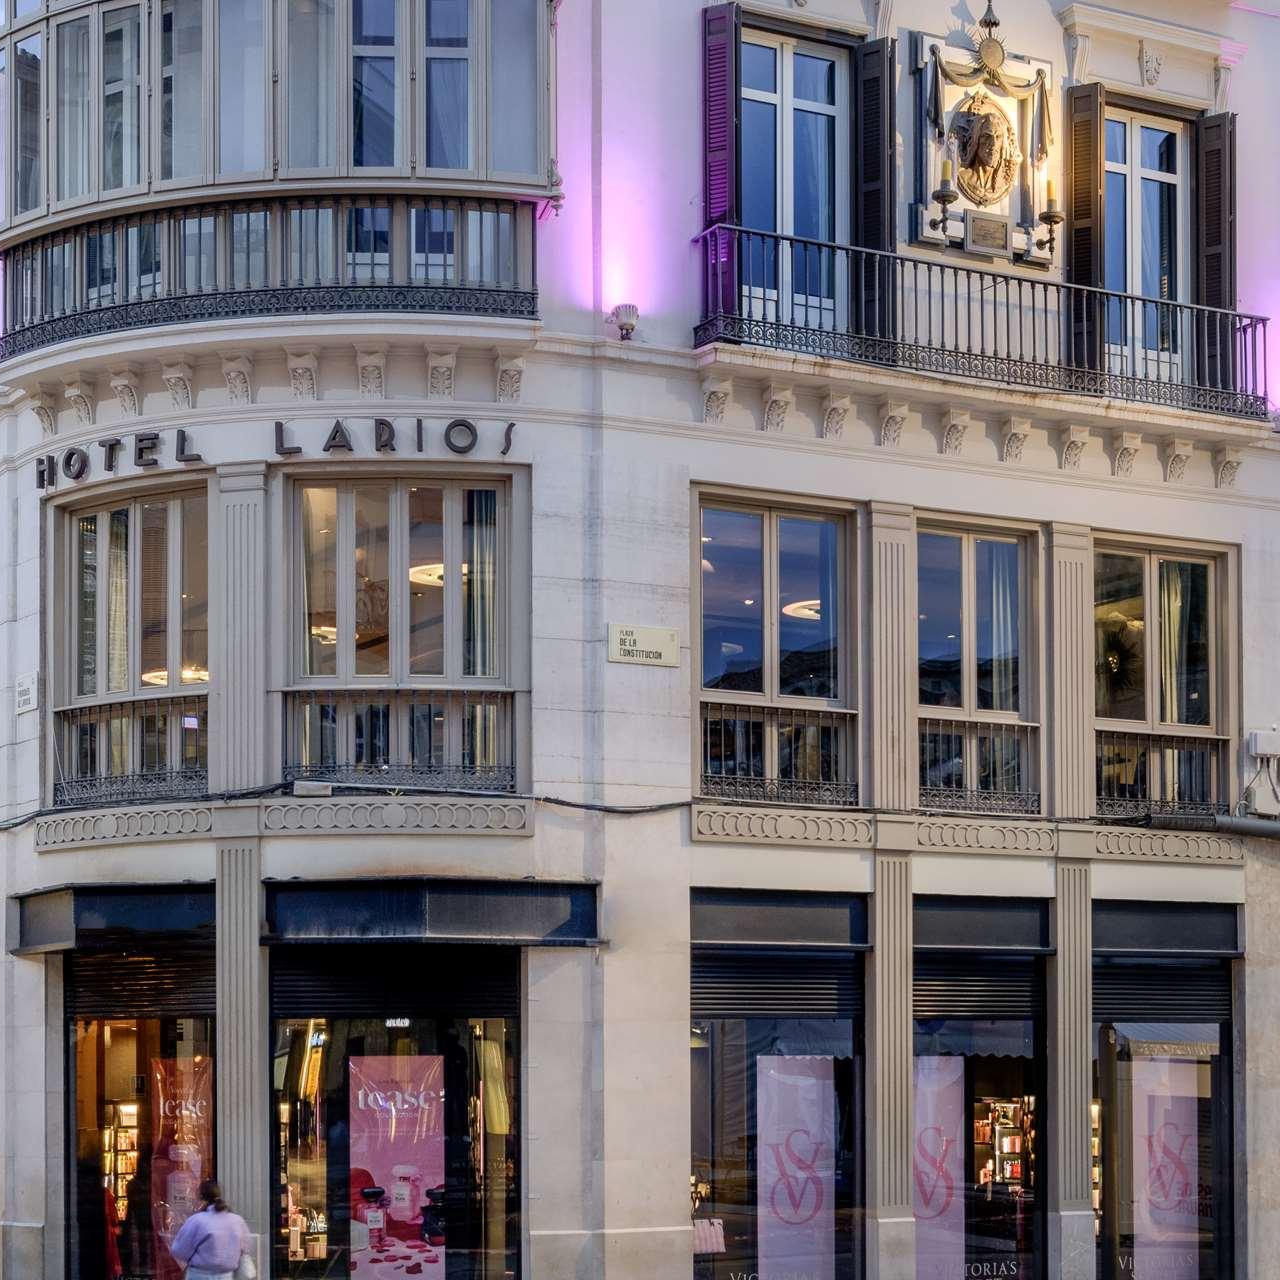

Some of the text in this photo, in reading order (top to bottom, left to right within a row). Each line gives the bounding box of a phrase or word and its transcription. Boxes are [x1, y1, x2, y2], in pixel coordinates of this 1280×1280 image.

[35, 418, 516, 489] HOTEL LARIOS
[619, 638, 637, 647] DE LA
[358, 1088, 435, 1110] tease
